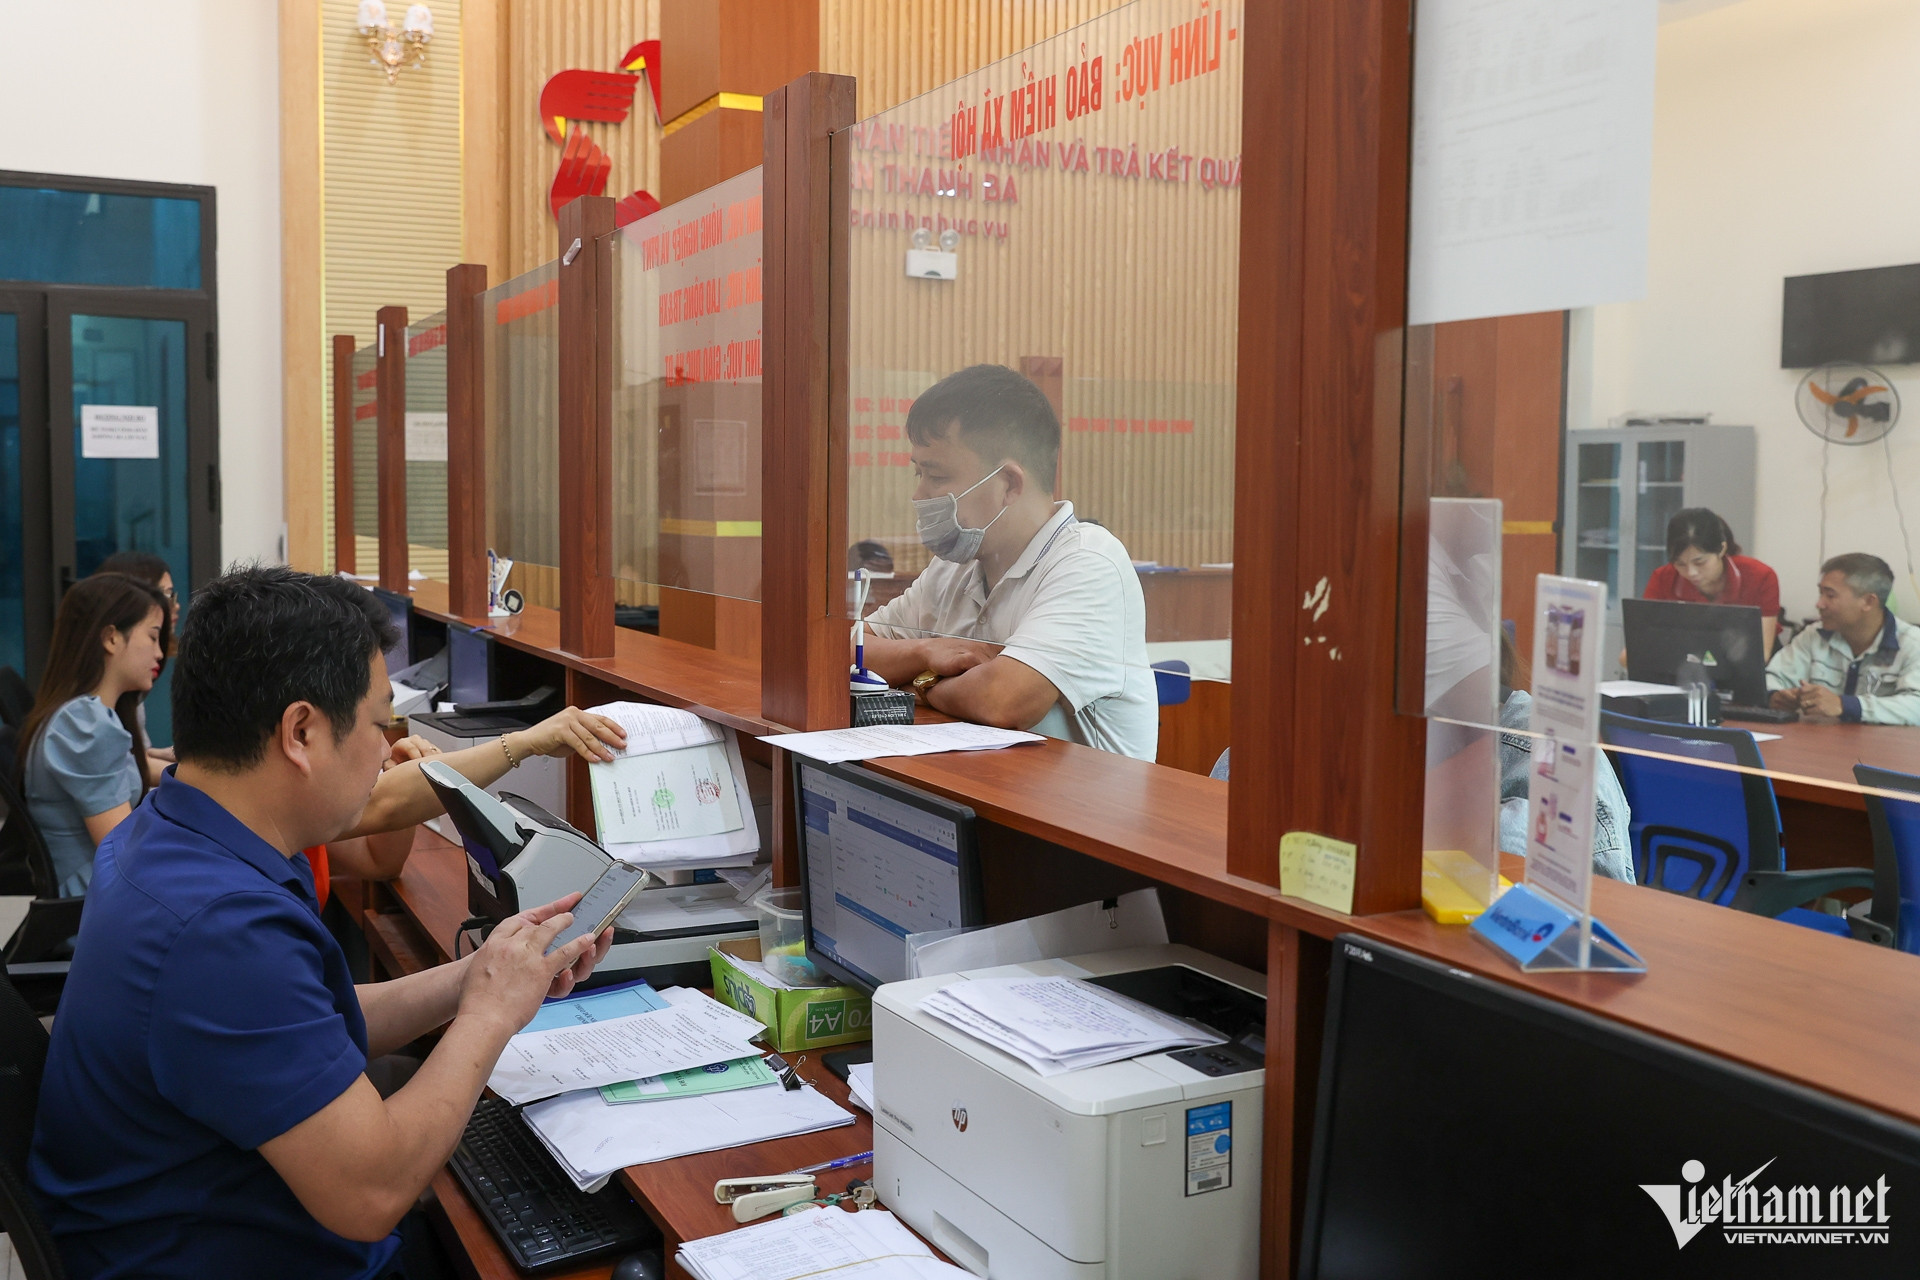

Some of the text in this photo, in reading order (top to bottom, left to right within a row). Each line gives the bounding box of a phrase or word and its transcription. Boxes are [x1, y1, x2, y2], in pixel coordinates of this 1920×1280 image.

[1058, 138, 1090, 174] VÀ
[1095, 143, 1141, 179] TRẢ
[1147, 144, 1193, 182] KẾT
[982, 173, 1018, 204] BA
[809, 1011, 842, 1034] A4
